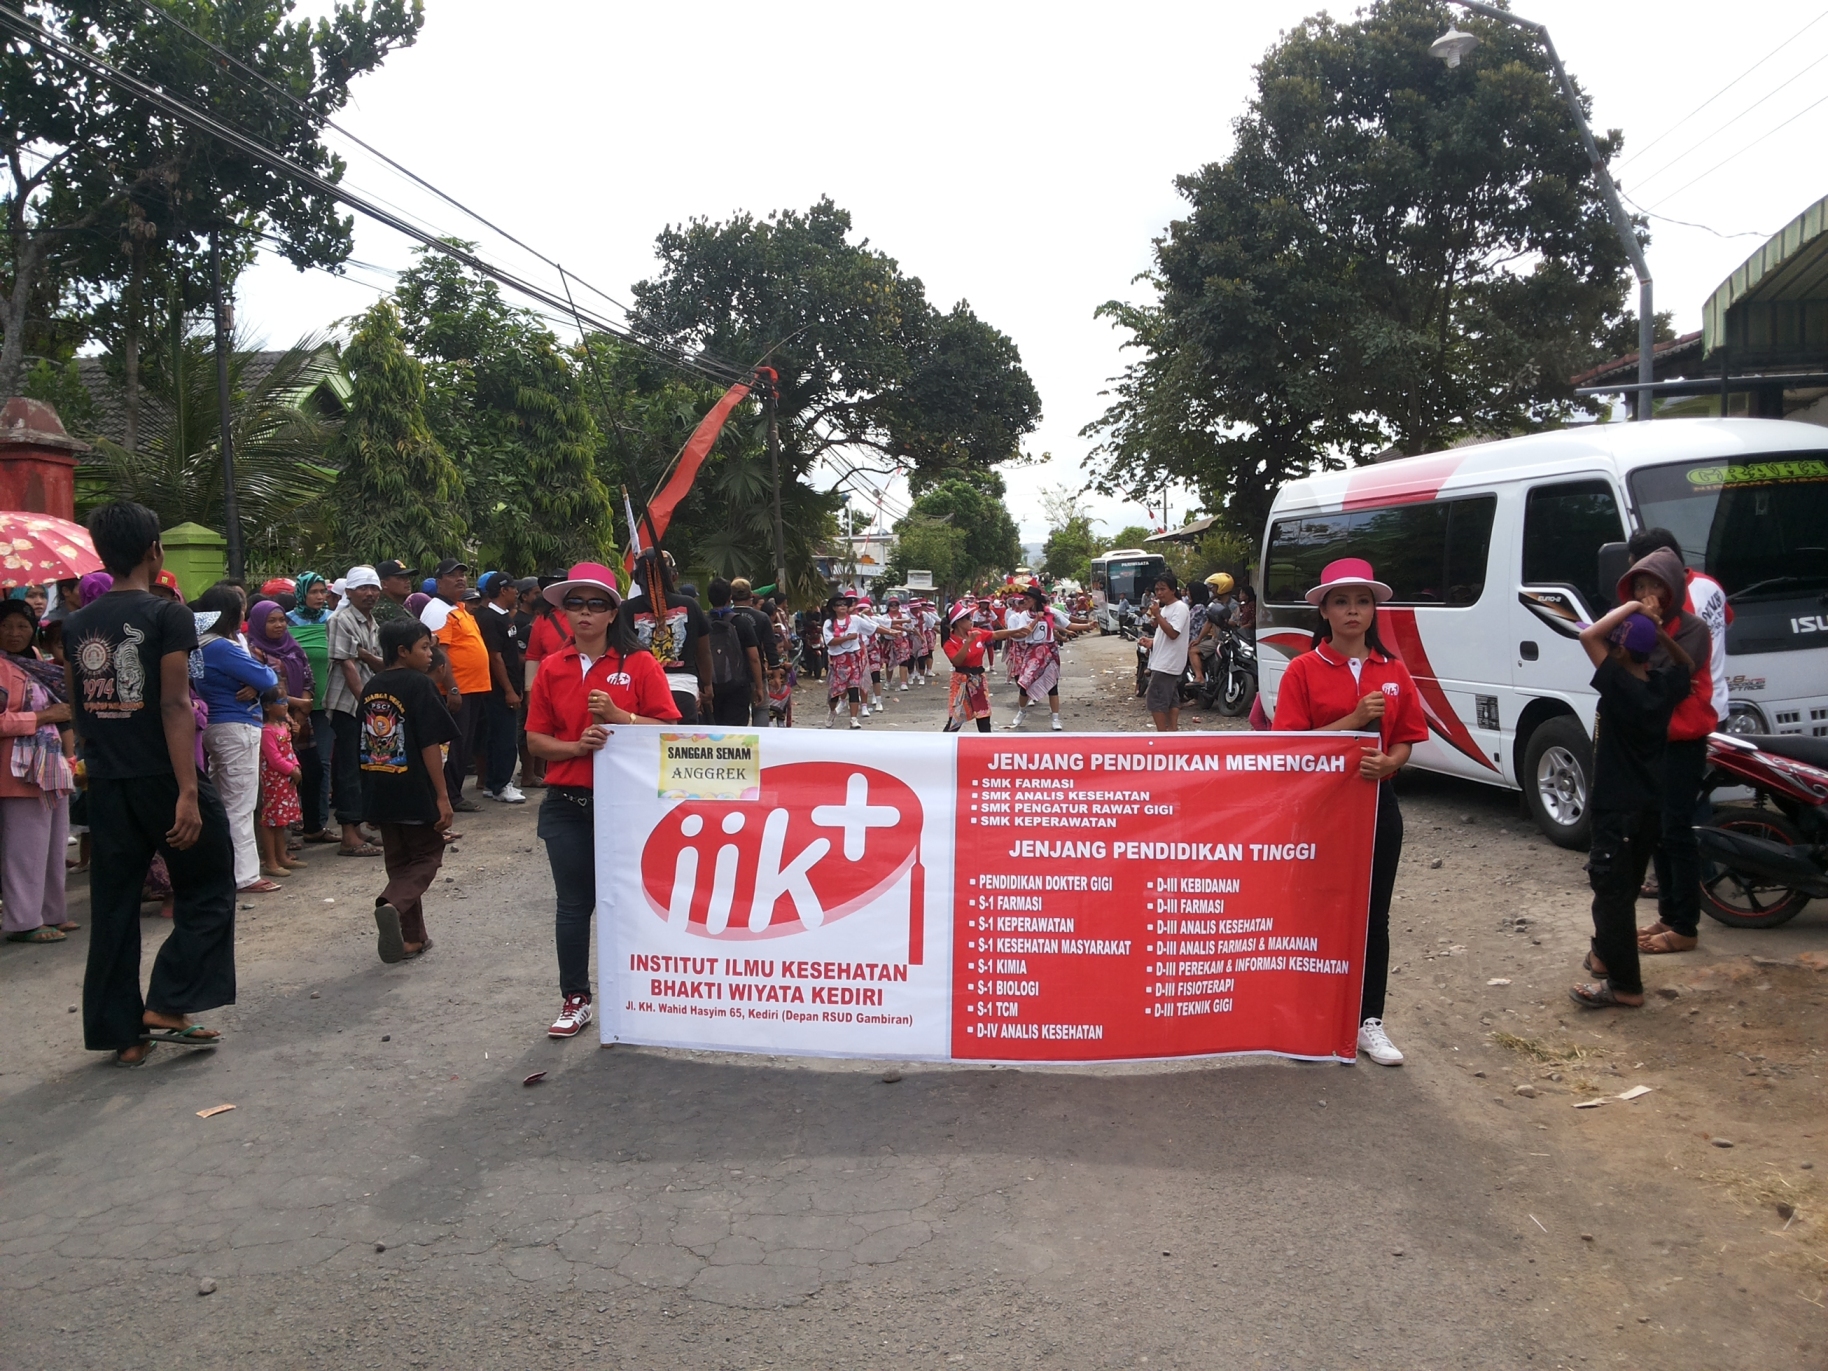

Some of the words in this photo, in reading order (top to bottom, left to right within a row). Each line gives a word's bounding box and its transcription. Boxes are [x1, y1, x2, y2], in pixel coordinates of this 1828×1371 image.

[1686, 460, 1828, 485] GRAHA
[83, 678, 115, 702] 1974
[668, 747, 713, 759] SANGGAR
[716, 747, 751, 760] SENAM
[987, 753, 1084, 771] JENJANG
[1091, 754, 1219, 771] PENDIDIKAN
[1226, 755, 1345, 772] MENENGAH
[671, 768, 747, 780] ANGGREK
[982, 778, 1011, 788] SMK
[1015, 779, 1074, 788] FARMASI
[981, 791, 1011, 800] SMK
[1015, 791, 1064, 800] ANALIS
[1068, 791, 1150, 801] KESEHATAN
[981, 803, 1010, 813] SMK
[1015, 803, 1088, 814] PENGATUR
[1092, 804, 1140, 814] RAWAT
[1144, 805, 1173, 815] GIGI
[980, 816, 1010, 826] SMK
[1014, 817, 1117, 827] KEPERAWATAN
[1009, 840, 1106, 858] JENJANG
[1113, 841, 1243, 861] PENDIDIKAN
[1249, 843, 1316, 861] TINGGI
[979, 874, 1042, 890] PENDIDIKAN
[1045, 875, 1088, 891] DOKTER
[1090, 876, 1113, 891] GIGI
[1157, 878, 1177, 892] D-III
[1180, 878, 1240, 893] KEBIDANAN
[979, 895, 994, 910] S-1
[997, 896, 1042, 911] FARMASI
[1157, 898, 1177, 913] D-III
[1180, 899, 1224, 914] FARMASI
[978, 916, 993, 931] S-1
[997, 917, 1074, 932] KEPERAWATAN
[1157, 920, 1177, 934] D-III
[1180, 920, 1216, 934] ANALIS
[1219, 917, 1273, 934] KESEHATAN
[978, 937, 993, 952] S-1
[997, 938, 1058, 954] KESEHATAN
[1061, 940, 1132, 955] MASYARAKAT
[1156, 941, 1177, 955] D-III
[1179, 941, 1215, 955] ANALIS
[1217, 938, 1257, 954] FARMASI
[1258, 937, 1265, 951] &
[1268, 937, 1318, 951] MAKANAN
[630, 954, 719, 975] INSTITUT
[725, 959, 774, 977] ILMU
[781, 961, 908, 982] KESEHATAN
[978, 958, 993, 974] S-1
[996, 959, 1027, 974] KIMIA
[1156, 962, 1176, 976] D-III
[1178, 960, 1224, 976] PEREKAM
[1226, 959, 1233, 972] &
[1235, 956, 1286, 971] INFORMASI
[1288, 956, 1349, 975] KESEHATAN
[650, 979, 722, 1000] BHAKTI
[728, 983, 805, 1004] WIYATA
[811, 986, 883, 1006] KEDIRI
[977, 980, 992, 995] S-1
[996, 980, 1039, 996] BIOLOGI
[1155, 982, 1175, 997] D-III
[1177, 978, 1235, 996] FISIOTERAPI
[625, 1000, 636, 1011] Jl.
[639, 1002, 656, 1012] KH.
[658, 1003, 687, 1015] Wahid
[690, 1006, 727, 1018] Hasyim
[729, 1008, 745, 1020] 65,
[748, 1009, 778, 1020] Kediri
[782, 1010, 819, 1023] (Depan
[822, 1012, 853, 1023] RSUD
[856, 1013, 913, 1027] Gambiran)
[977, 1001, 992, 1016] S-1
[996, 1002, 1018, 1017] TCM
[1154, 1003, 1174, 1018] D-III
[1176, 1000, 1211, 1017] TEKNIK
[1213, 998, 1233, 1013] GIGI
[976, 1023, 998, 1038] D-IV
[1000, 1024, 1039, 1039] ANALIS
[1042, 1024, 1103, 1039] KESEHATAN
